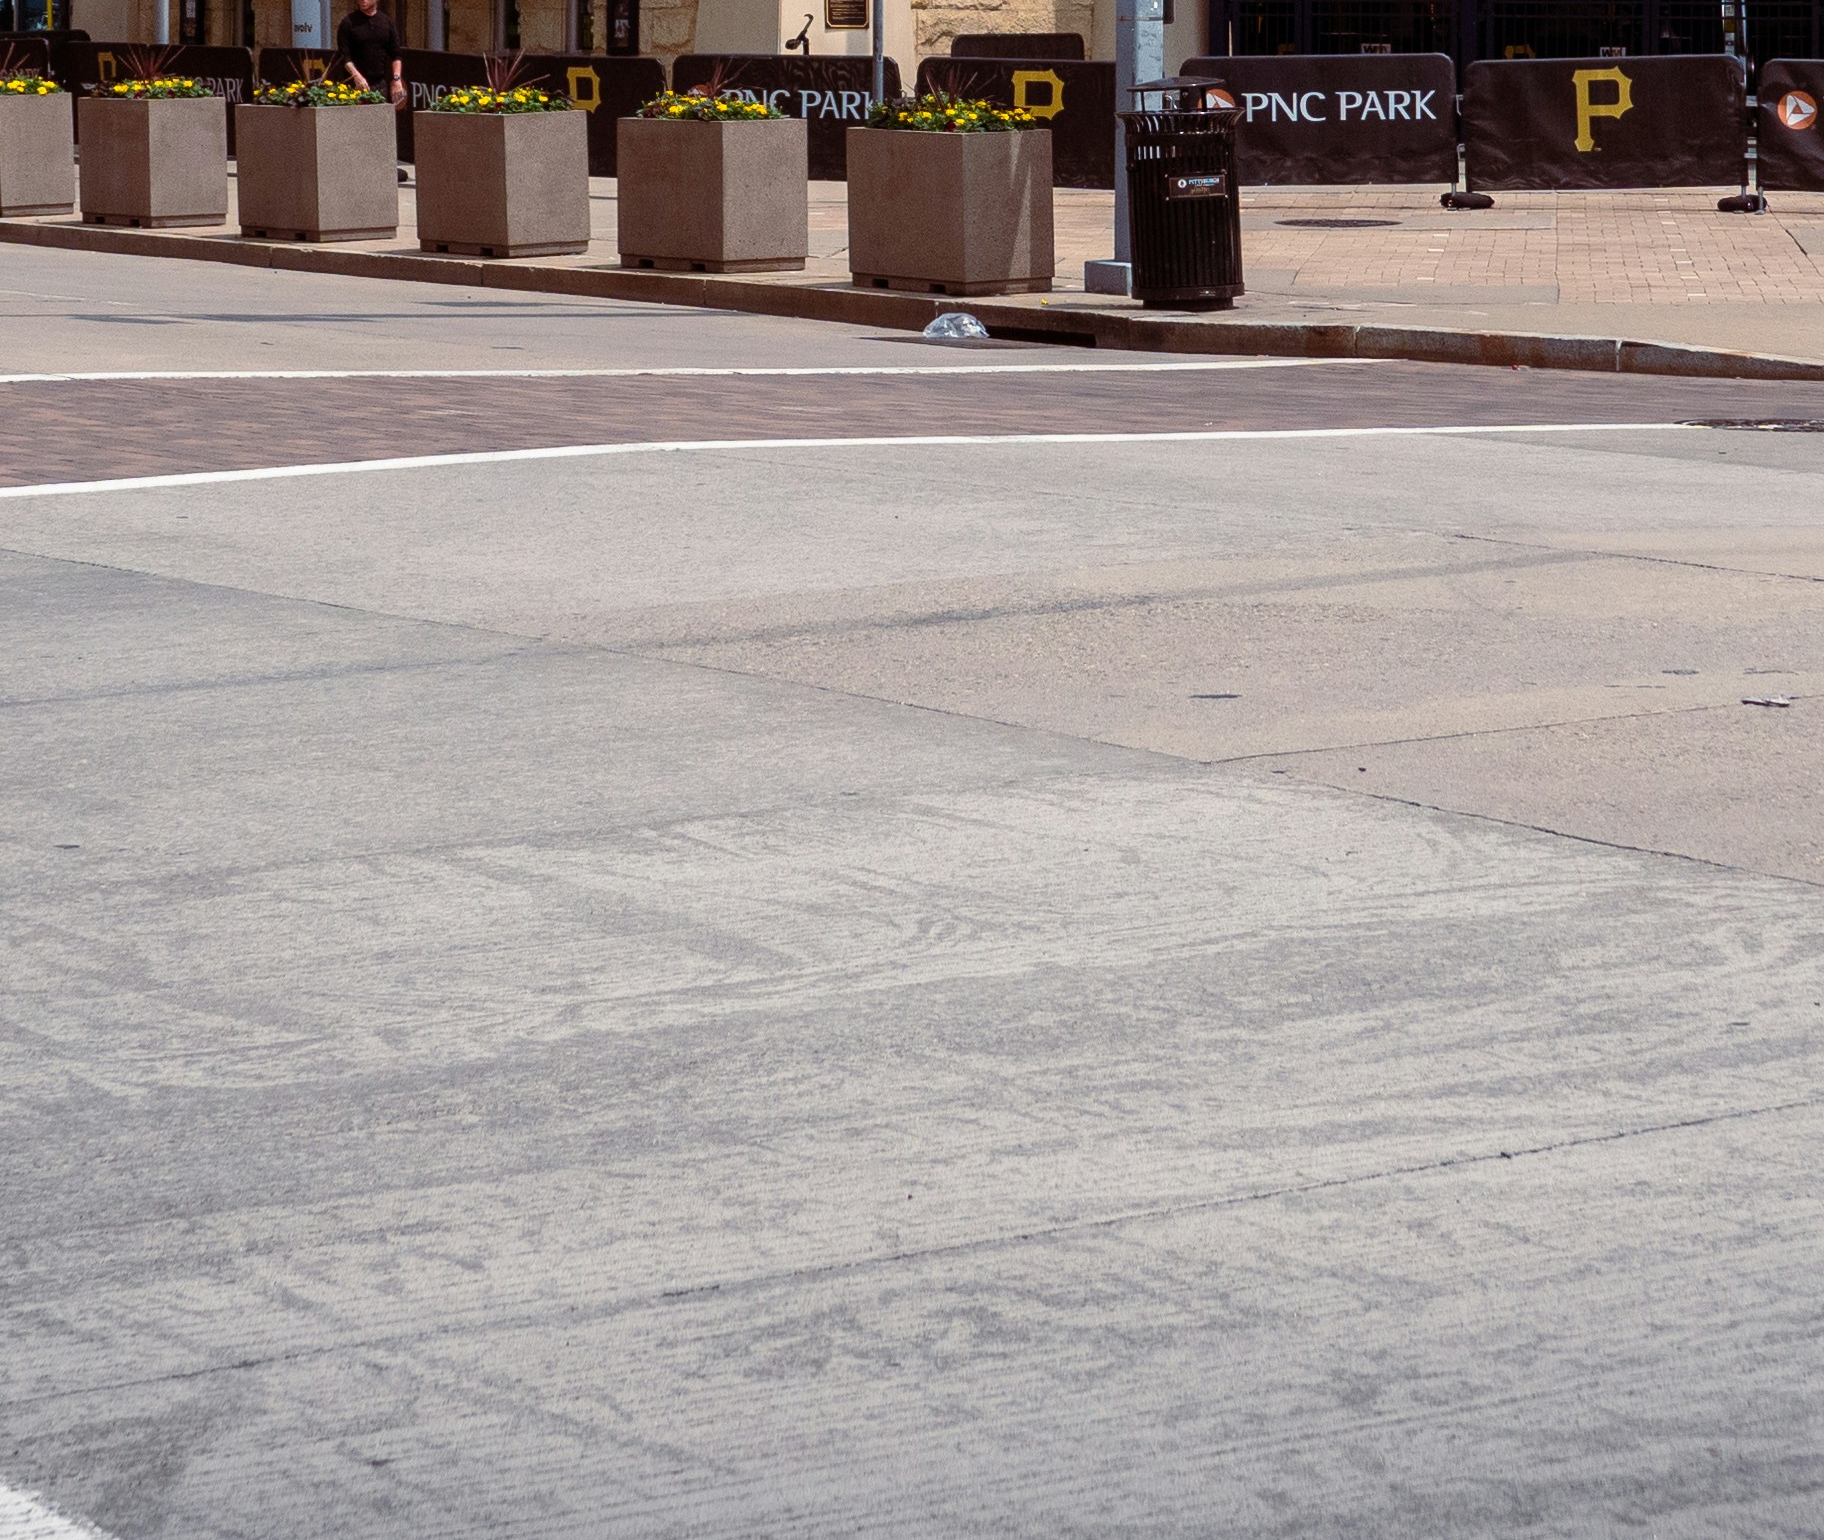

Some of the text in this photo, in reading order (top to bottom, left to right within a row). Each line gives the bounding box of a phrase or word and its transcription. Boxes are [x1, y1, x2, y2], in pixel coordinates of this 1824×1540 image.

[1241, 90, 1437, 122] PNC PARK
[1572, 67, 1633, 152] P
